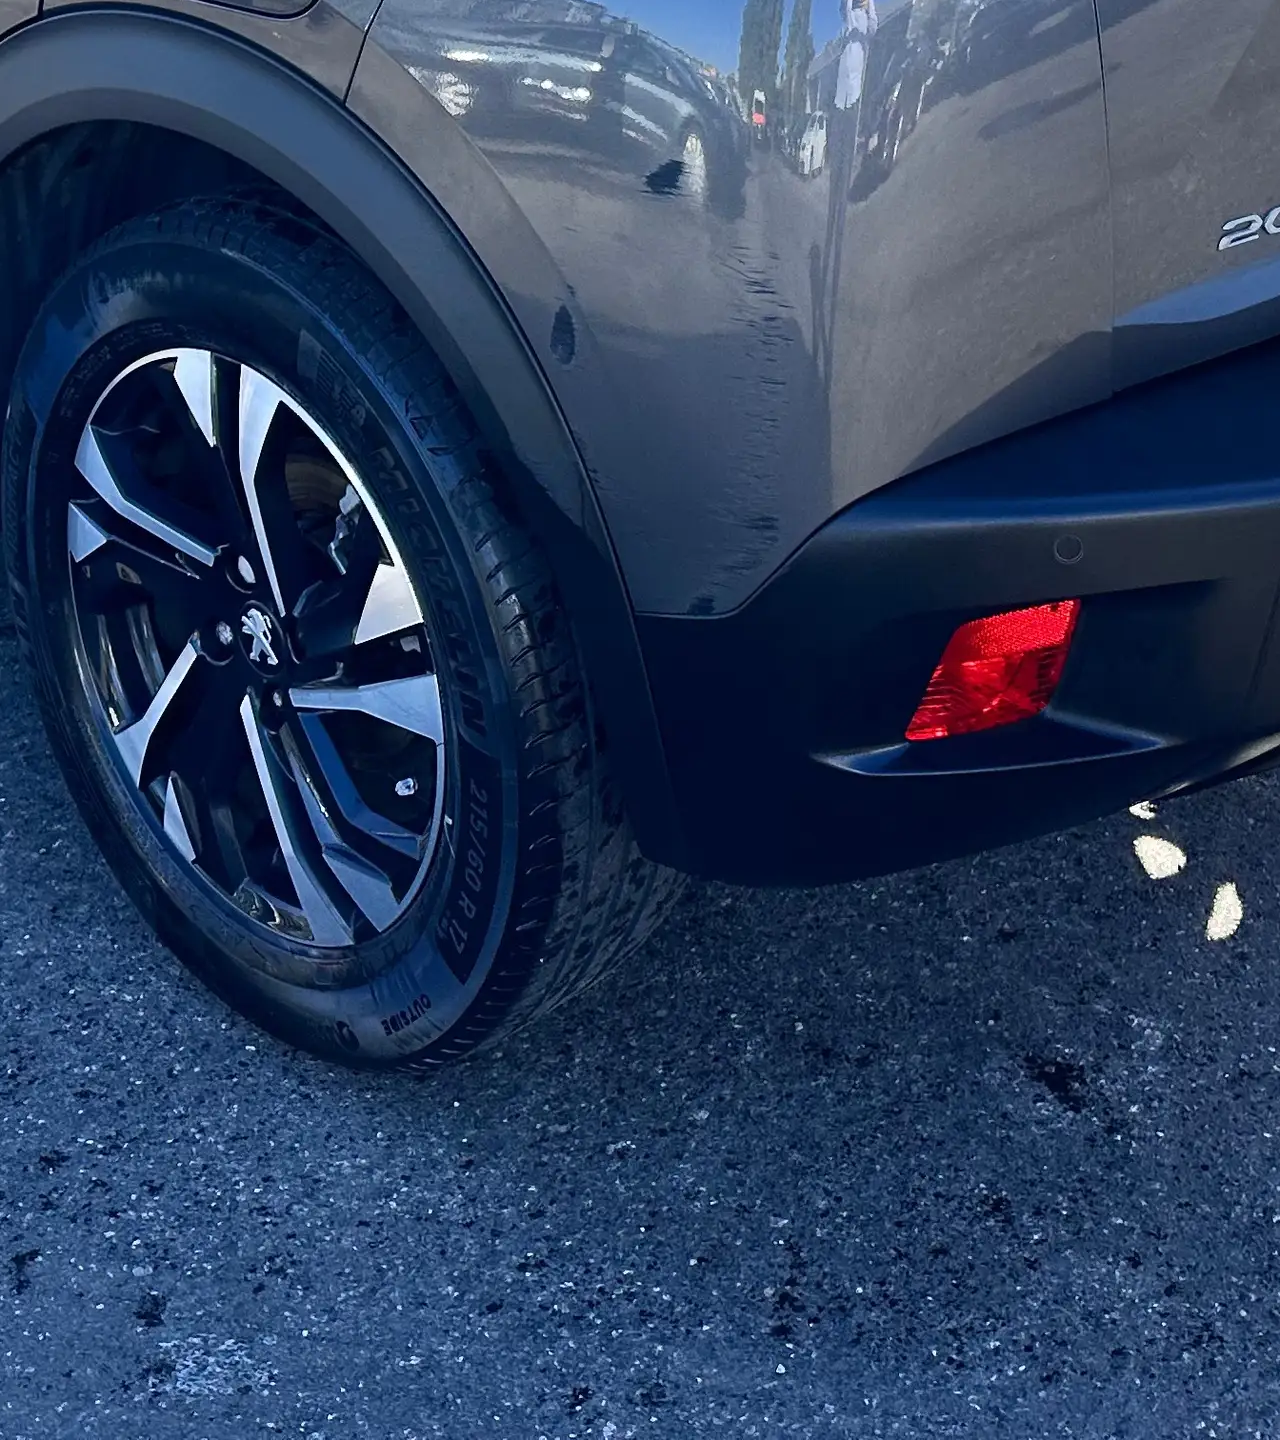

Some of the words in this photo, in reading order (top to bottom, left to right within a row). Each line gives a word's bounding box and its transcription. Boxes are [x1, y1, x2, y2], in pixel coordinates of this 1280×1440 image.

[368, 444, 488, 738] MICHELIN
[465, 776, 489, 893] 215/60
[458, 890, 477, 920] R
[450, 917, 468, 954] 17
[380, 993, 432, 1036] OUTSIDE
